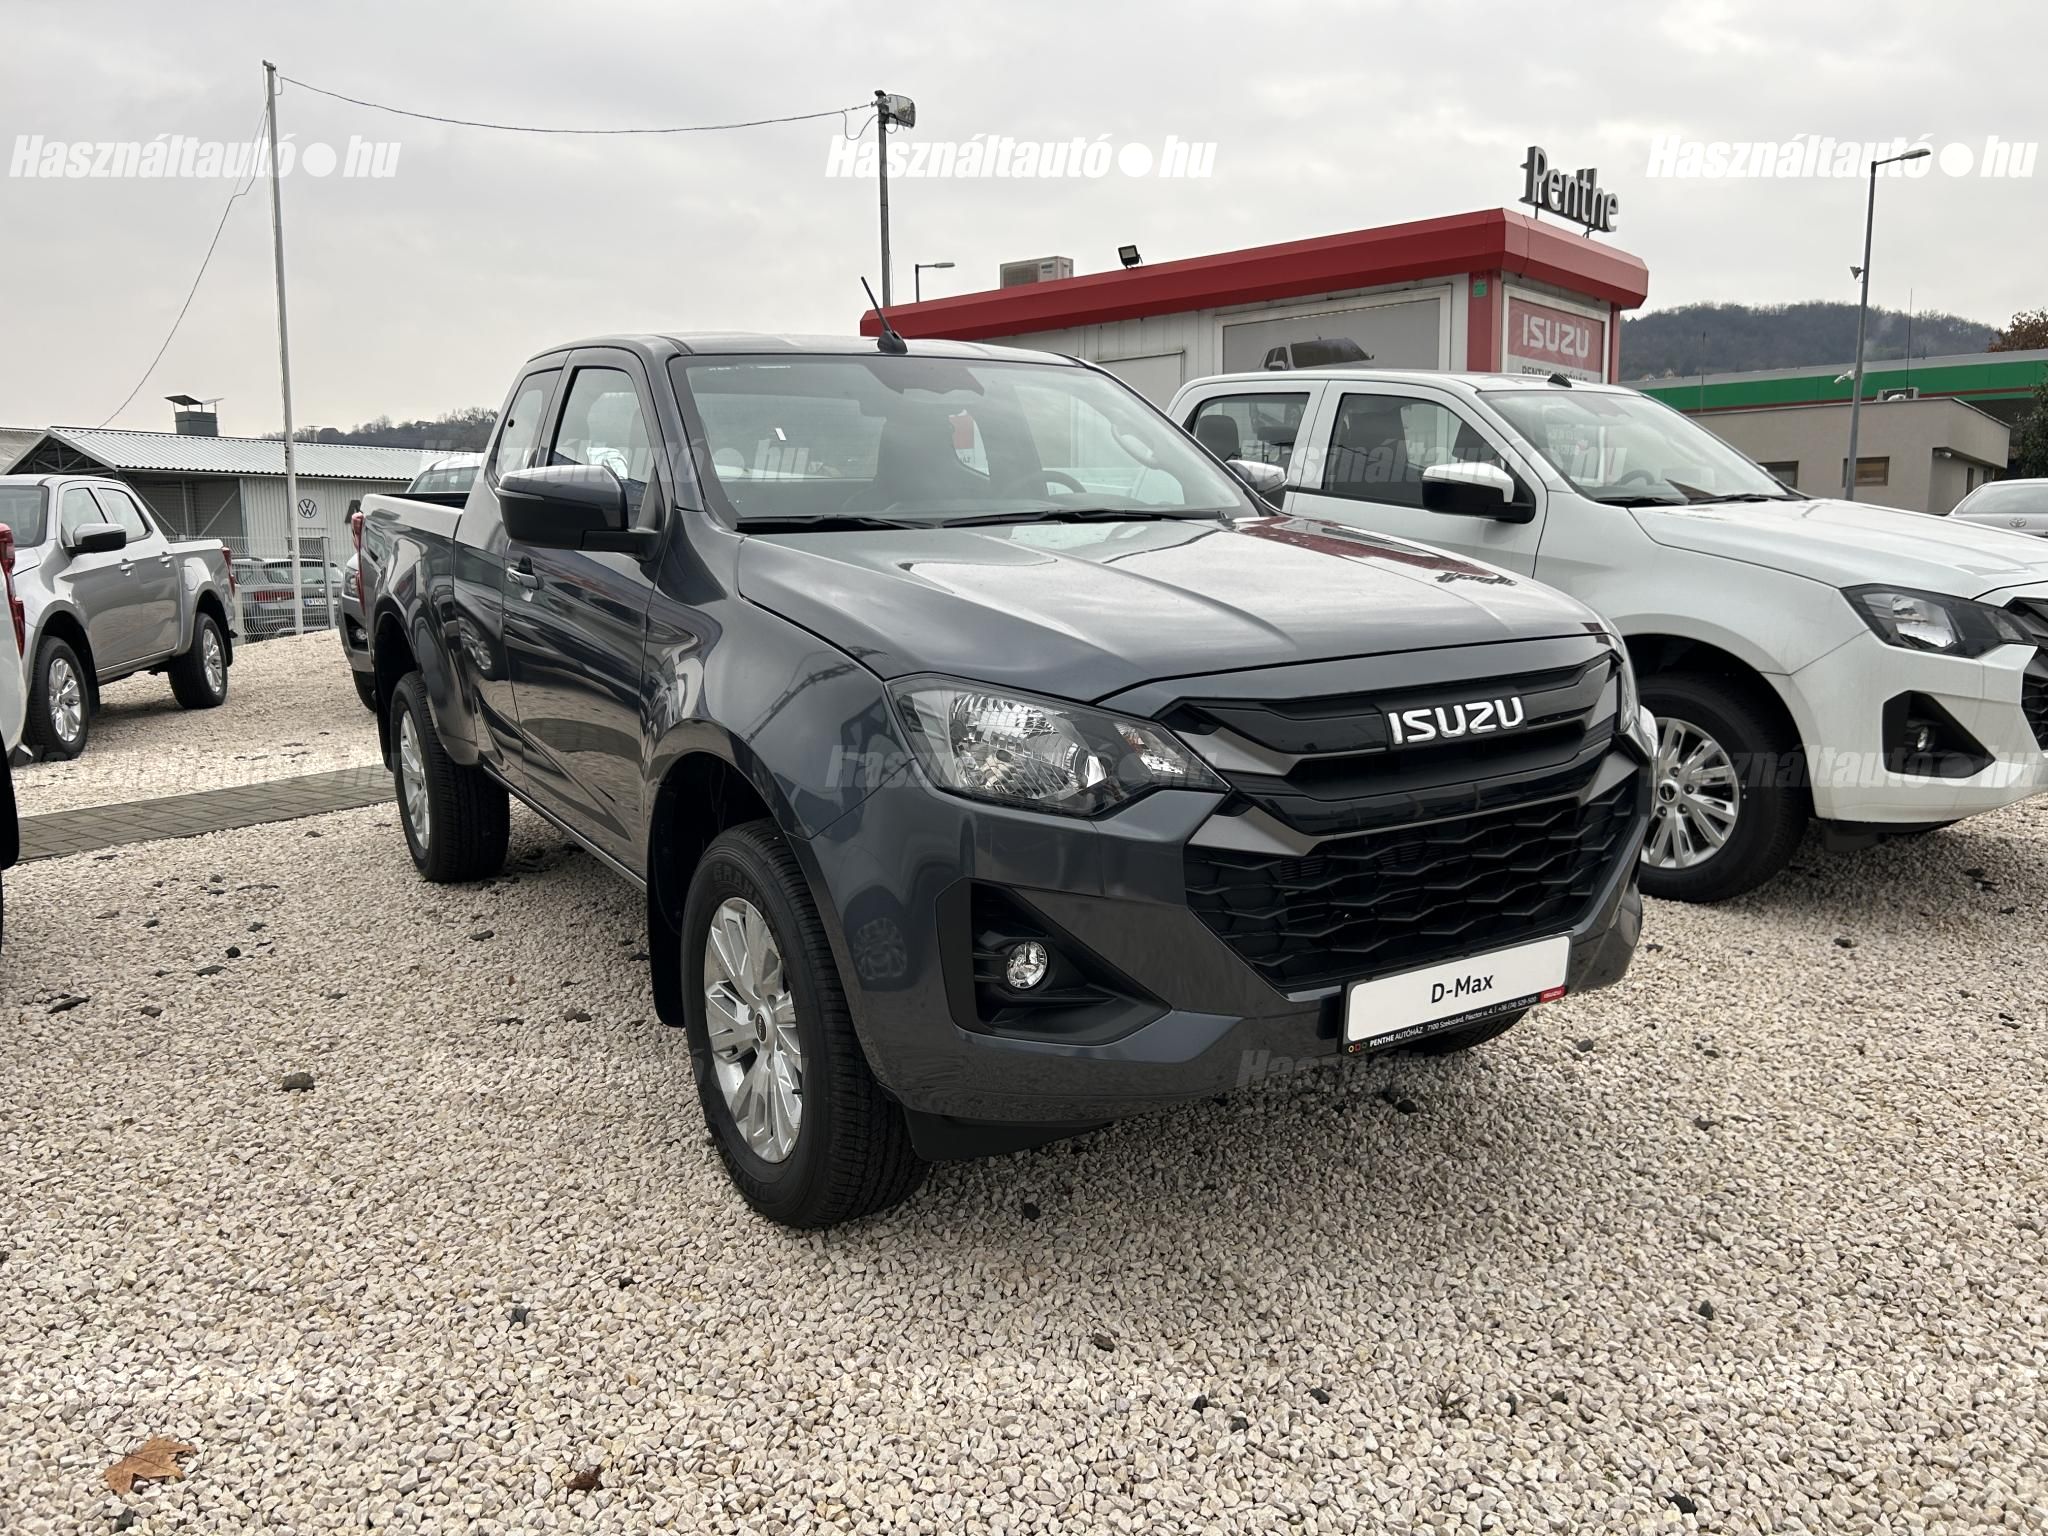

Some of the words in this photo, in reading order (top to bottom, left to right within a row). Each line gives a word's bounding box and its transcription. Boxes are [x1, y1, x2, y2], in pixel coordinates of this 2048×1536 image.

[1519, 145, 1619, 232] Penthe
[1522, 312, 1590, 359] ISUZU
[1388, 696, 1524, 744] ISUZU
[1431, 975, 1494, 1004] D-Max
[1369, 1034, 1395, 1048] PENTHE
